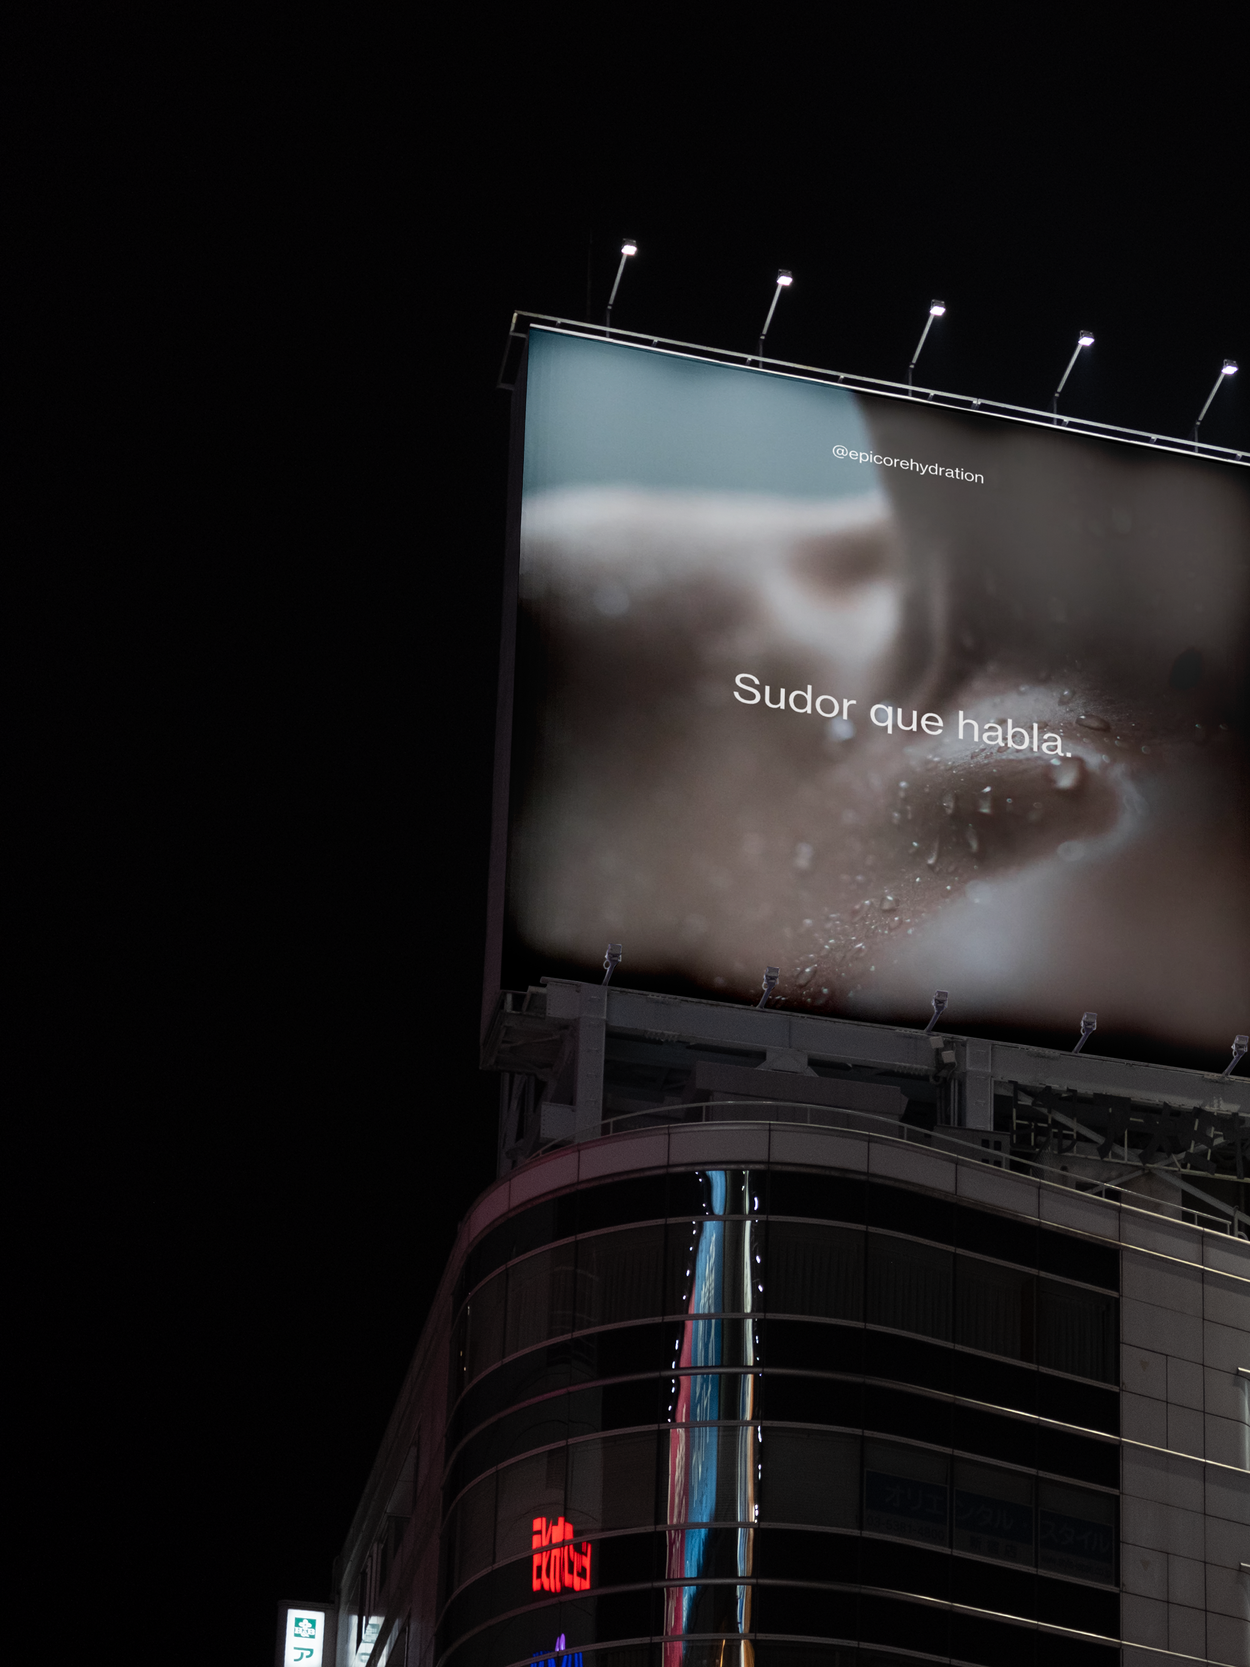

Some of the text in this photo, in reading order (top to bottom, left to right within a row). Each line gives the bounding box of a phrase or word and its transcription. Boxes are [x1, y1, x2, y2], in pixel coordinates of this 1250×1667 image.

[832, 444, 984, 484] @epicorehydration
[733, 673, 1072, 758] Sudor que habla.
